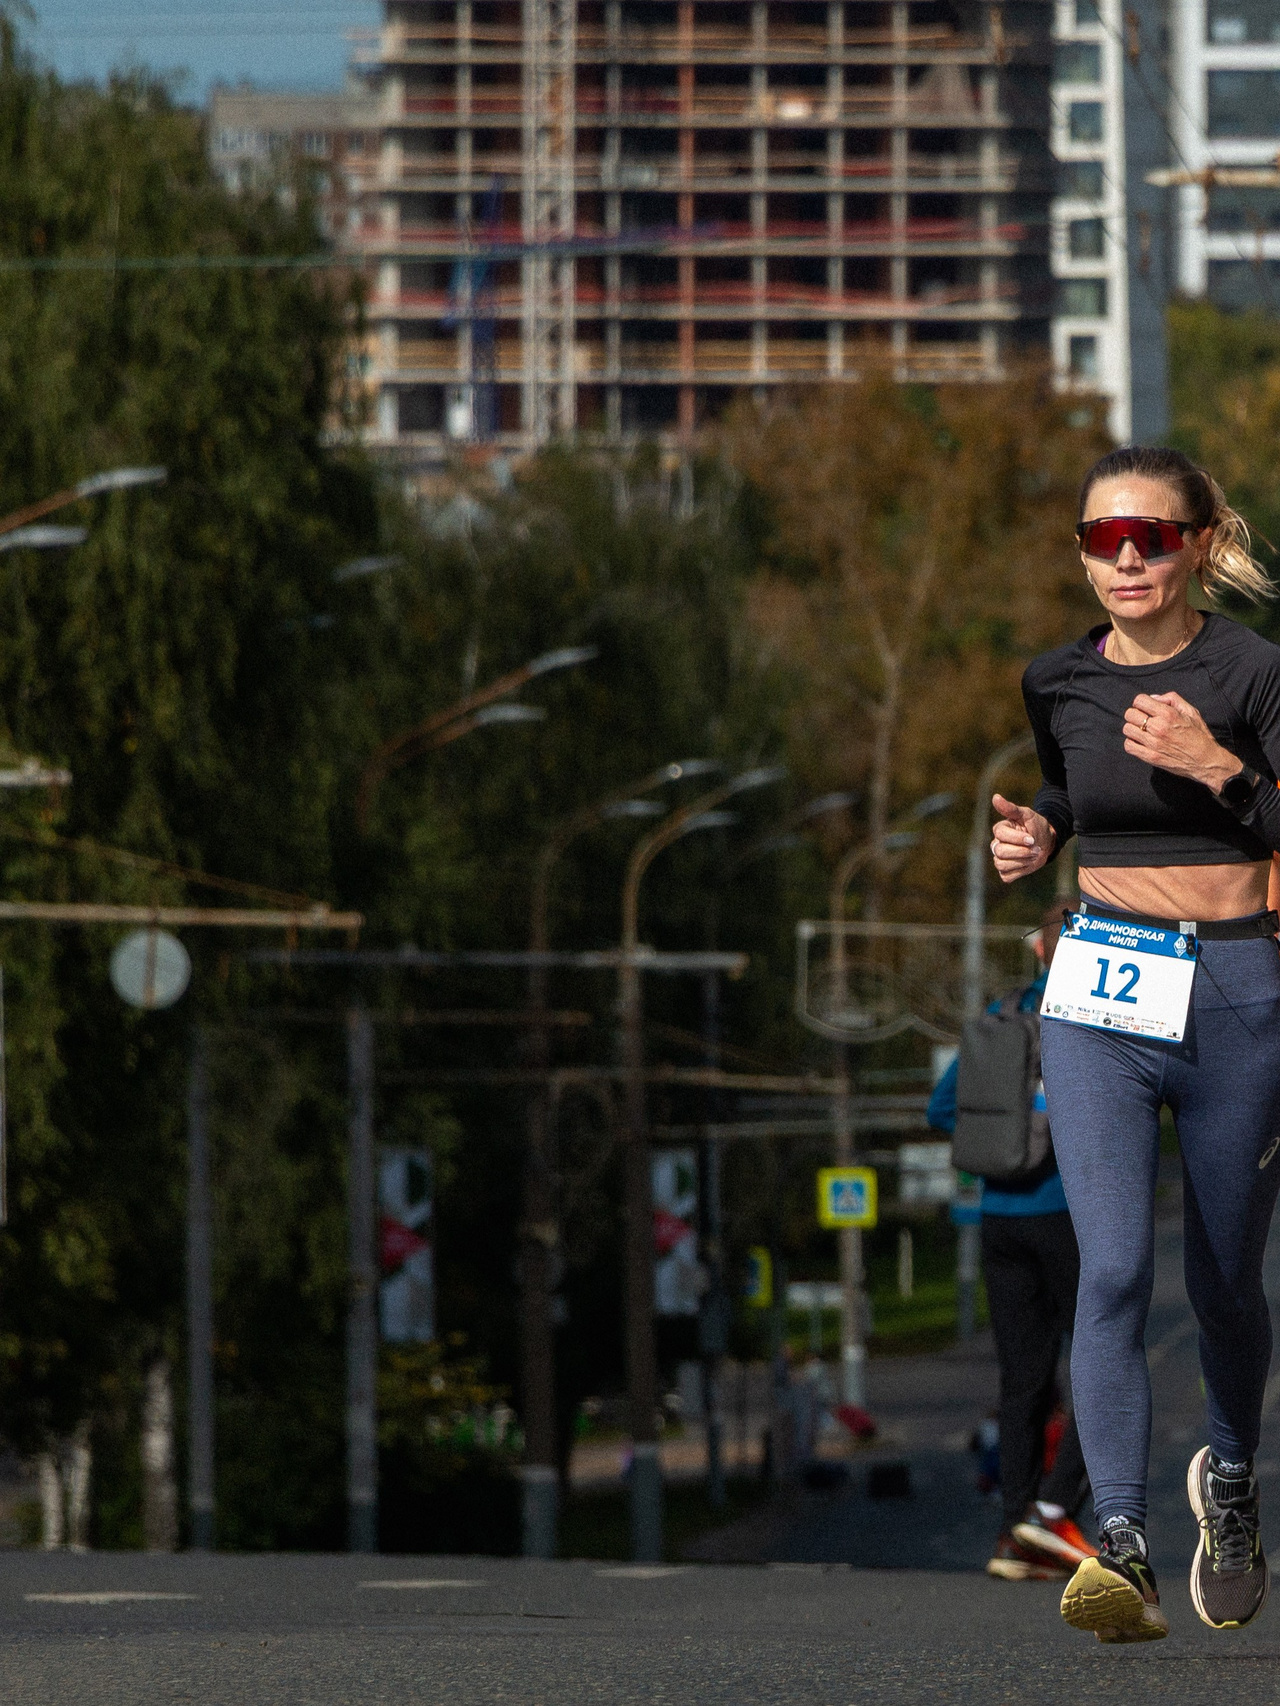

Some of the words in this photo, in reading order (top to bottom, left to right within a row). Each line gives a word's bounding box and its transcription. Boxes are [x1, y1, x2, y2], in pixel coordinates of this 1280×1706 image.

[1089, 920, 1165, 942] ДИНАМОВСКАЯ
[1108, 934, 1138, 948] МИЛЯ
[1090, 957, 1141, 1004] 12
